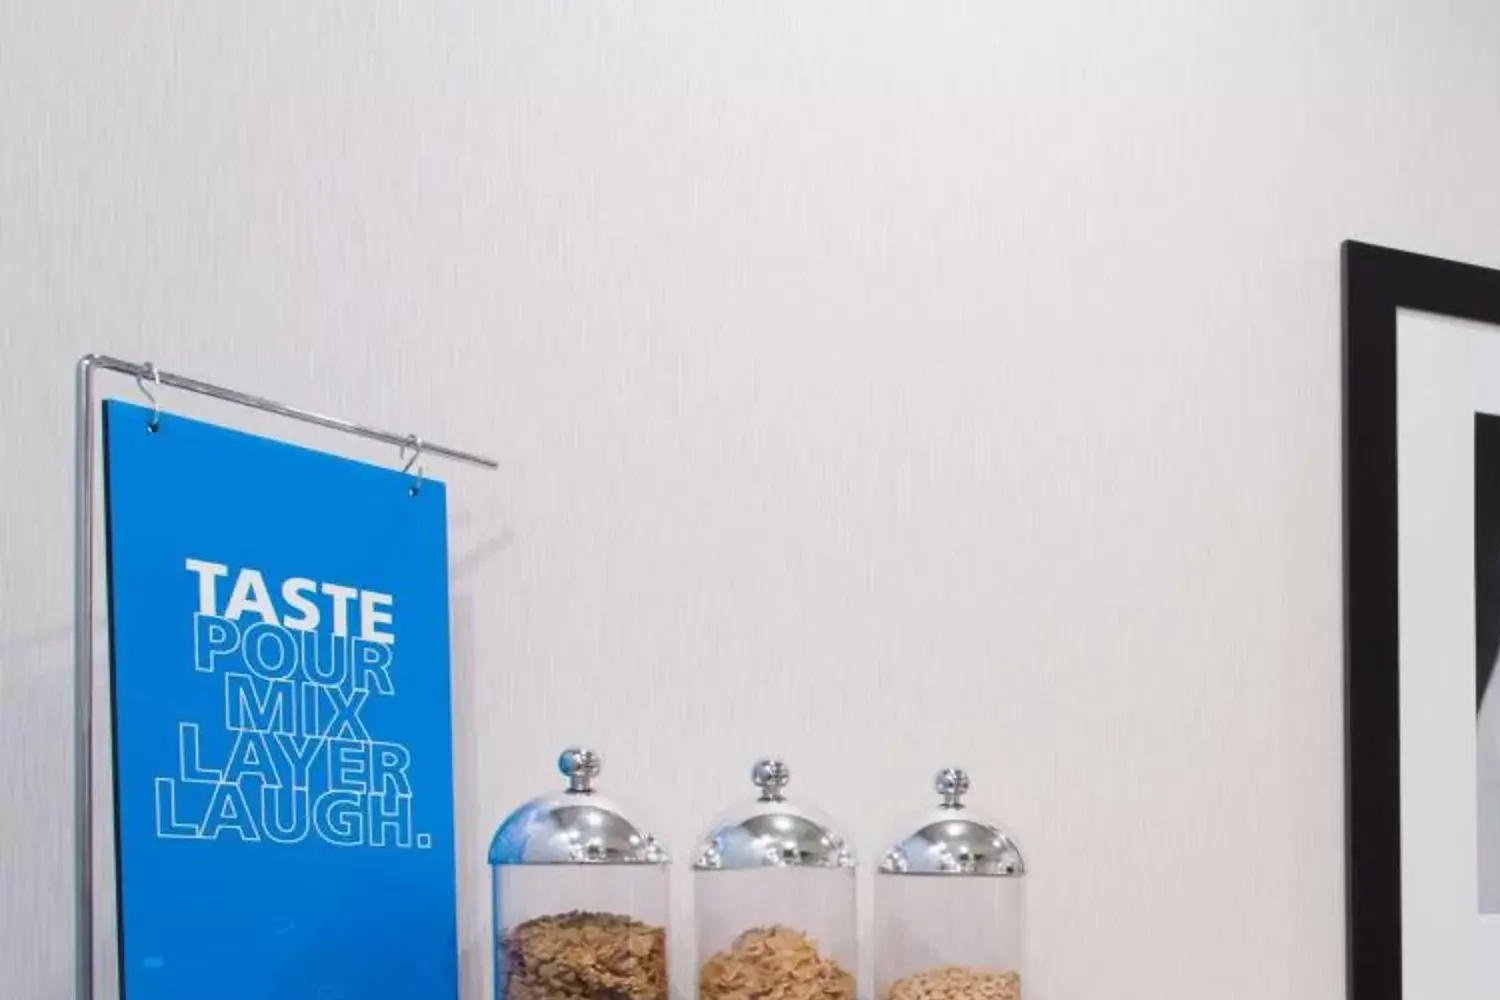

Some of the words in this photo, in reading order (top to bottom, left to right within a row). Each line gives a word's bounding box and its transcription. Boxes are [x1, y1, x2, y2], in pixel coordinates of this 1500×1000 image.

[185, 558, 395, 645] TASTE
[194, 612, 395, 695] POUR
[225, 671, 373, 743] MIX
[179, 722, 413, 798] LAYER
[155, 777, 432, 849] LAUGH.
